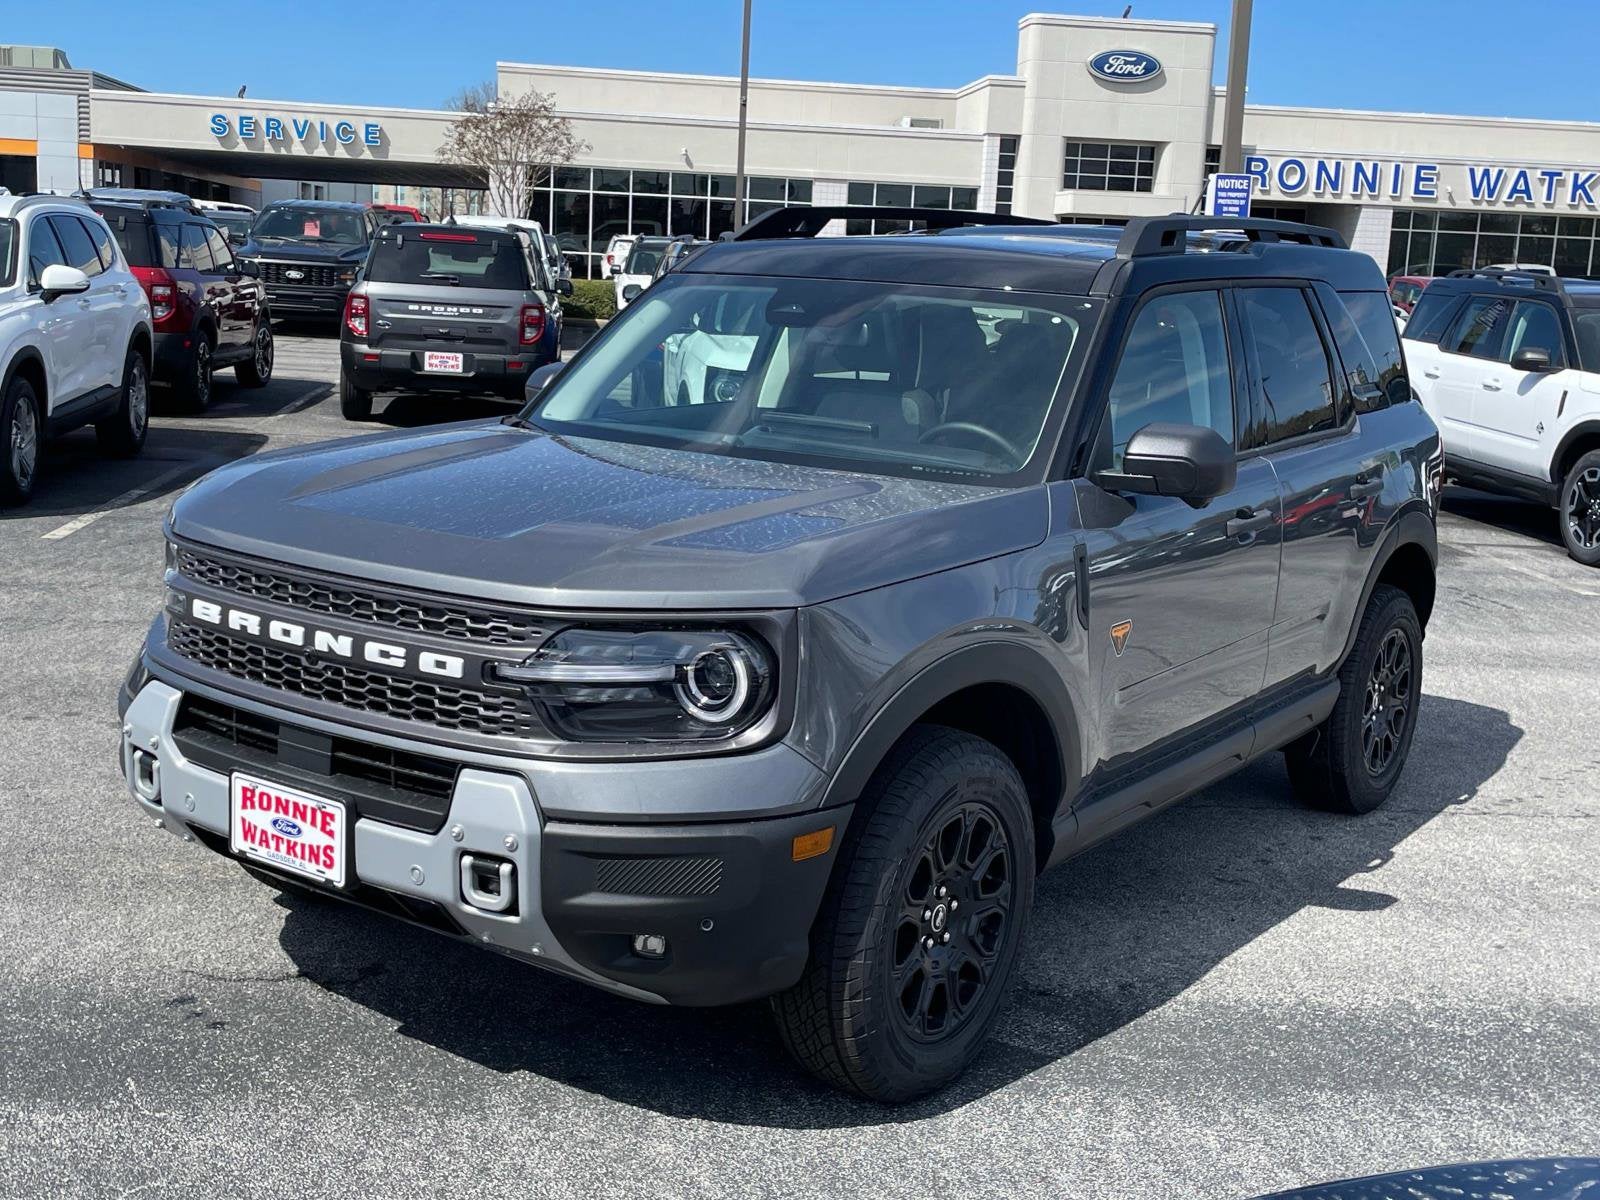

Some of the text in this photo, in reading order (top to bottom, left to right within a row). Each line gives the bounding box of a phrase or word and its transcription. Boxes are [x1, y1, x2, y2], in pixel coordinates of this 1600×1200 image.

[1103, 55, 1147, 75] Ford
[210, 113, 381, 146] SERVICE
[1217, 178, 1249, 190] NOTICE
[1245, 156, 1600, 205] RONNIE WATK
[408, 305, 483, 314] BRONCO
[428, 353, 460, 362] RONNIE
[428, 362, 460, 370] WATKINS
[192, 599, 464, 678] BRONCO
[240, 785, 336, 840] RONNIE
[274, 819, 300, 836] Ford
[240, 815, 335, 870] WATKINS
